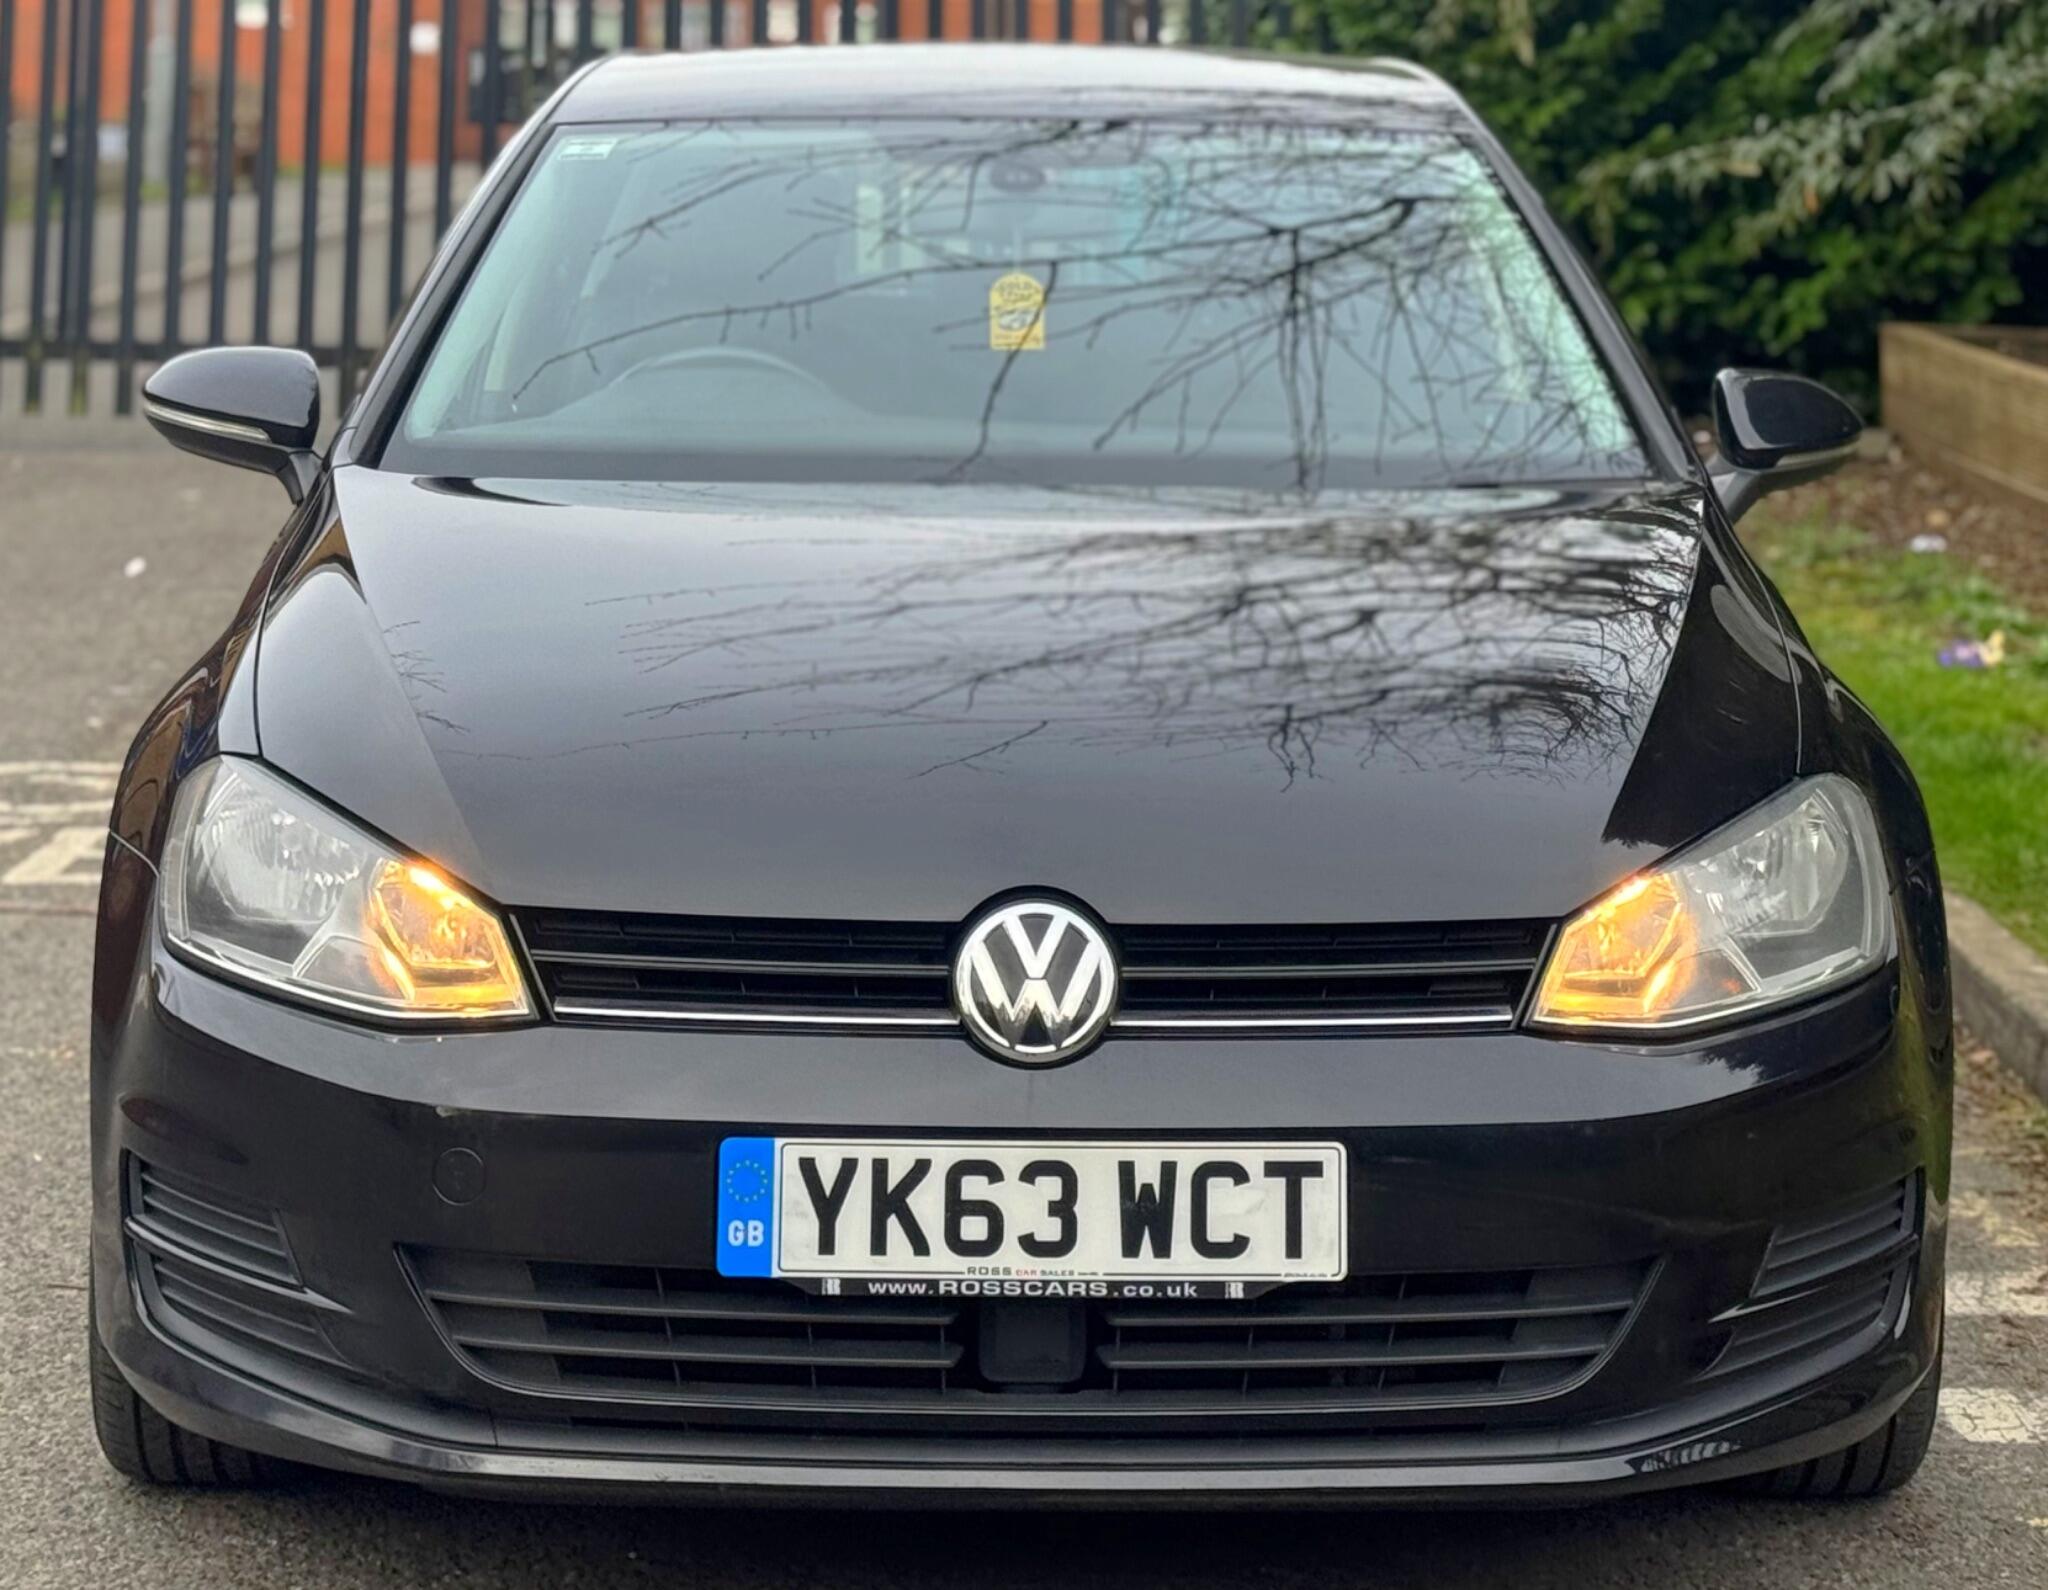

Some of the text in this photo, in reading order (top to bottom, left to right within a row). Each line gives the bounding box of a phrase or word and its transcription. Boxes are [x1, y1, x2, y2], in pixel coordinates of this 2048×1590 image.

[798, 1157, 1323, 1259] YK63 WCT
[728, 1221, 764, 1247] GB
[967, 1266, 1012, 1276] ROSS
[1016, 1269, 1037, 1277] CAR
[868, 1279, 1198, 1298] www.ROSSCARS.co.uk
